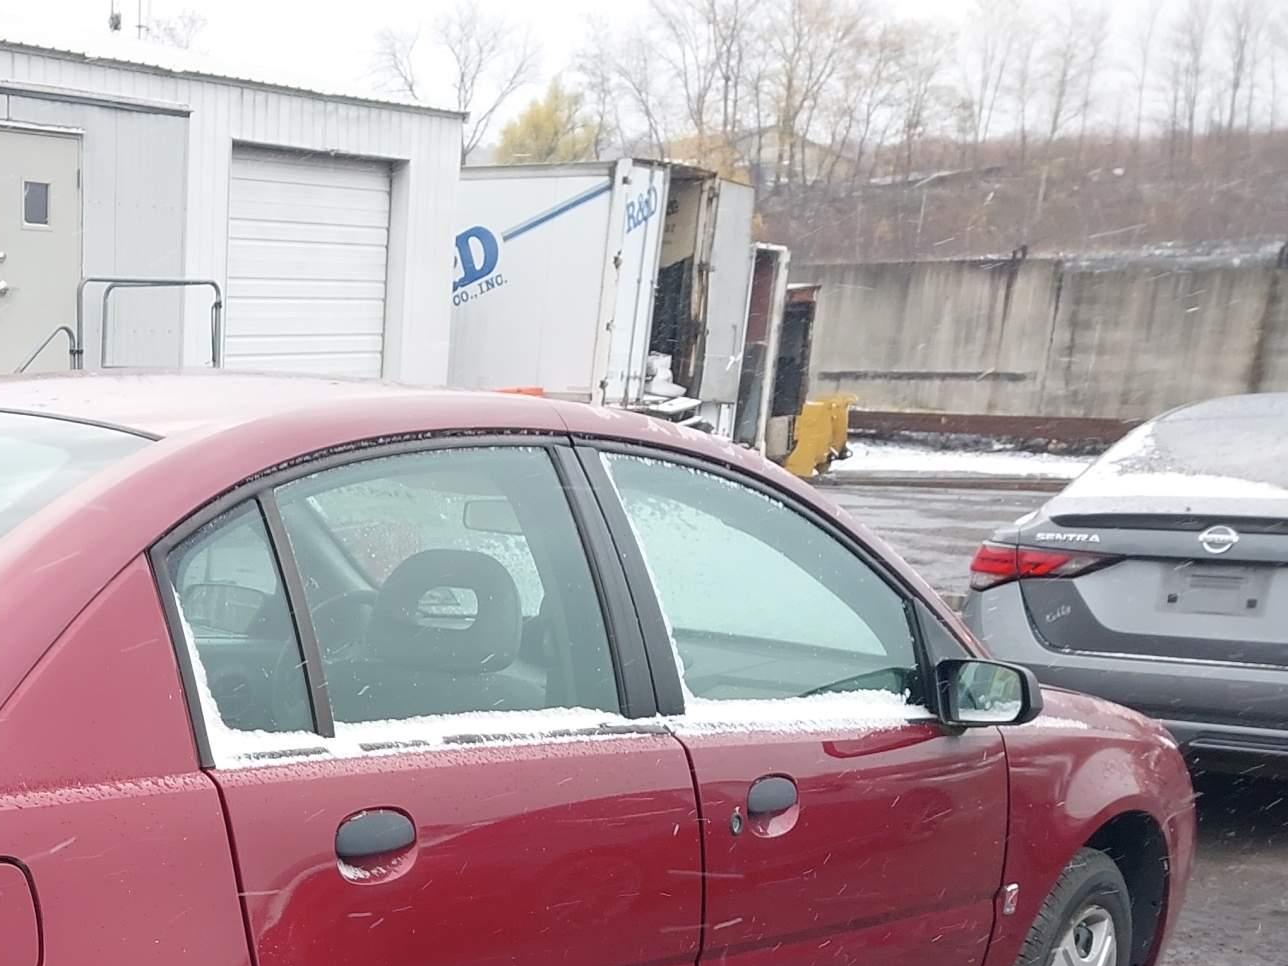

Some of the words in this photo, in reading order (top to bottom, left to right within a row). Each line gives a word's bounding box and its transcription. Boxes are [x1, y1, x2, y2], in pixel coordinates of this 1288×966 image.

[626, 186, 658, 234] R&D
[452, 225, 499, 292] D
[1035, 532, 1102, 544] SENTRA
